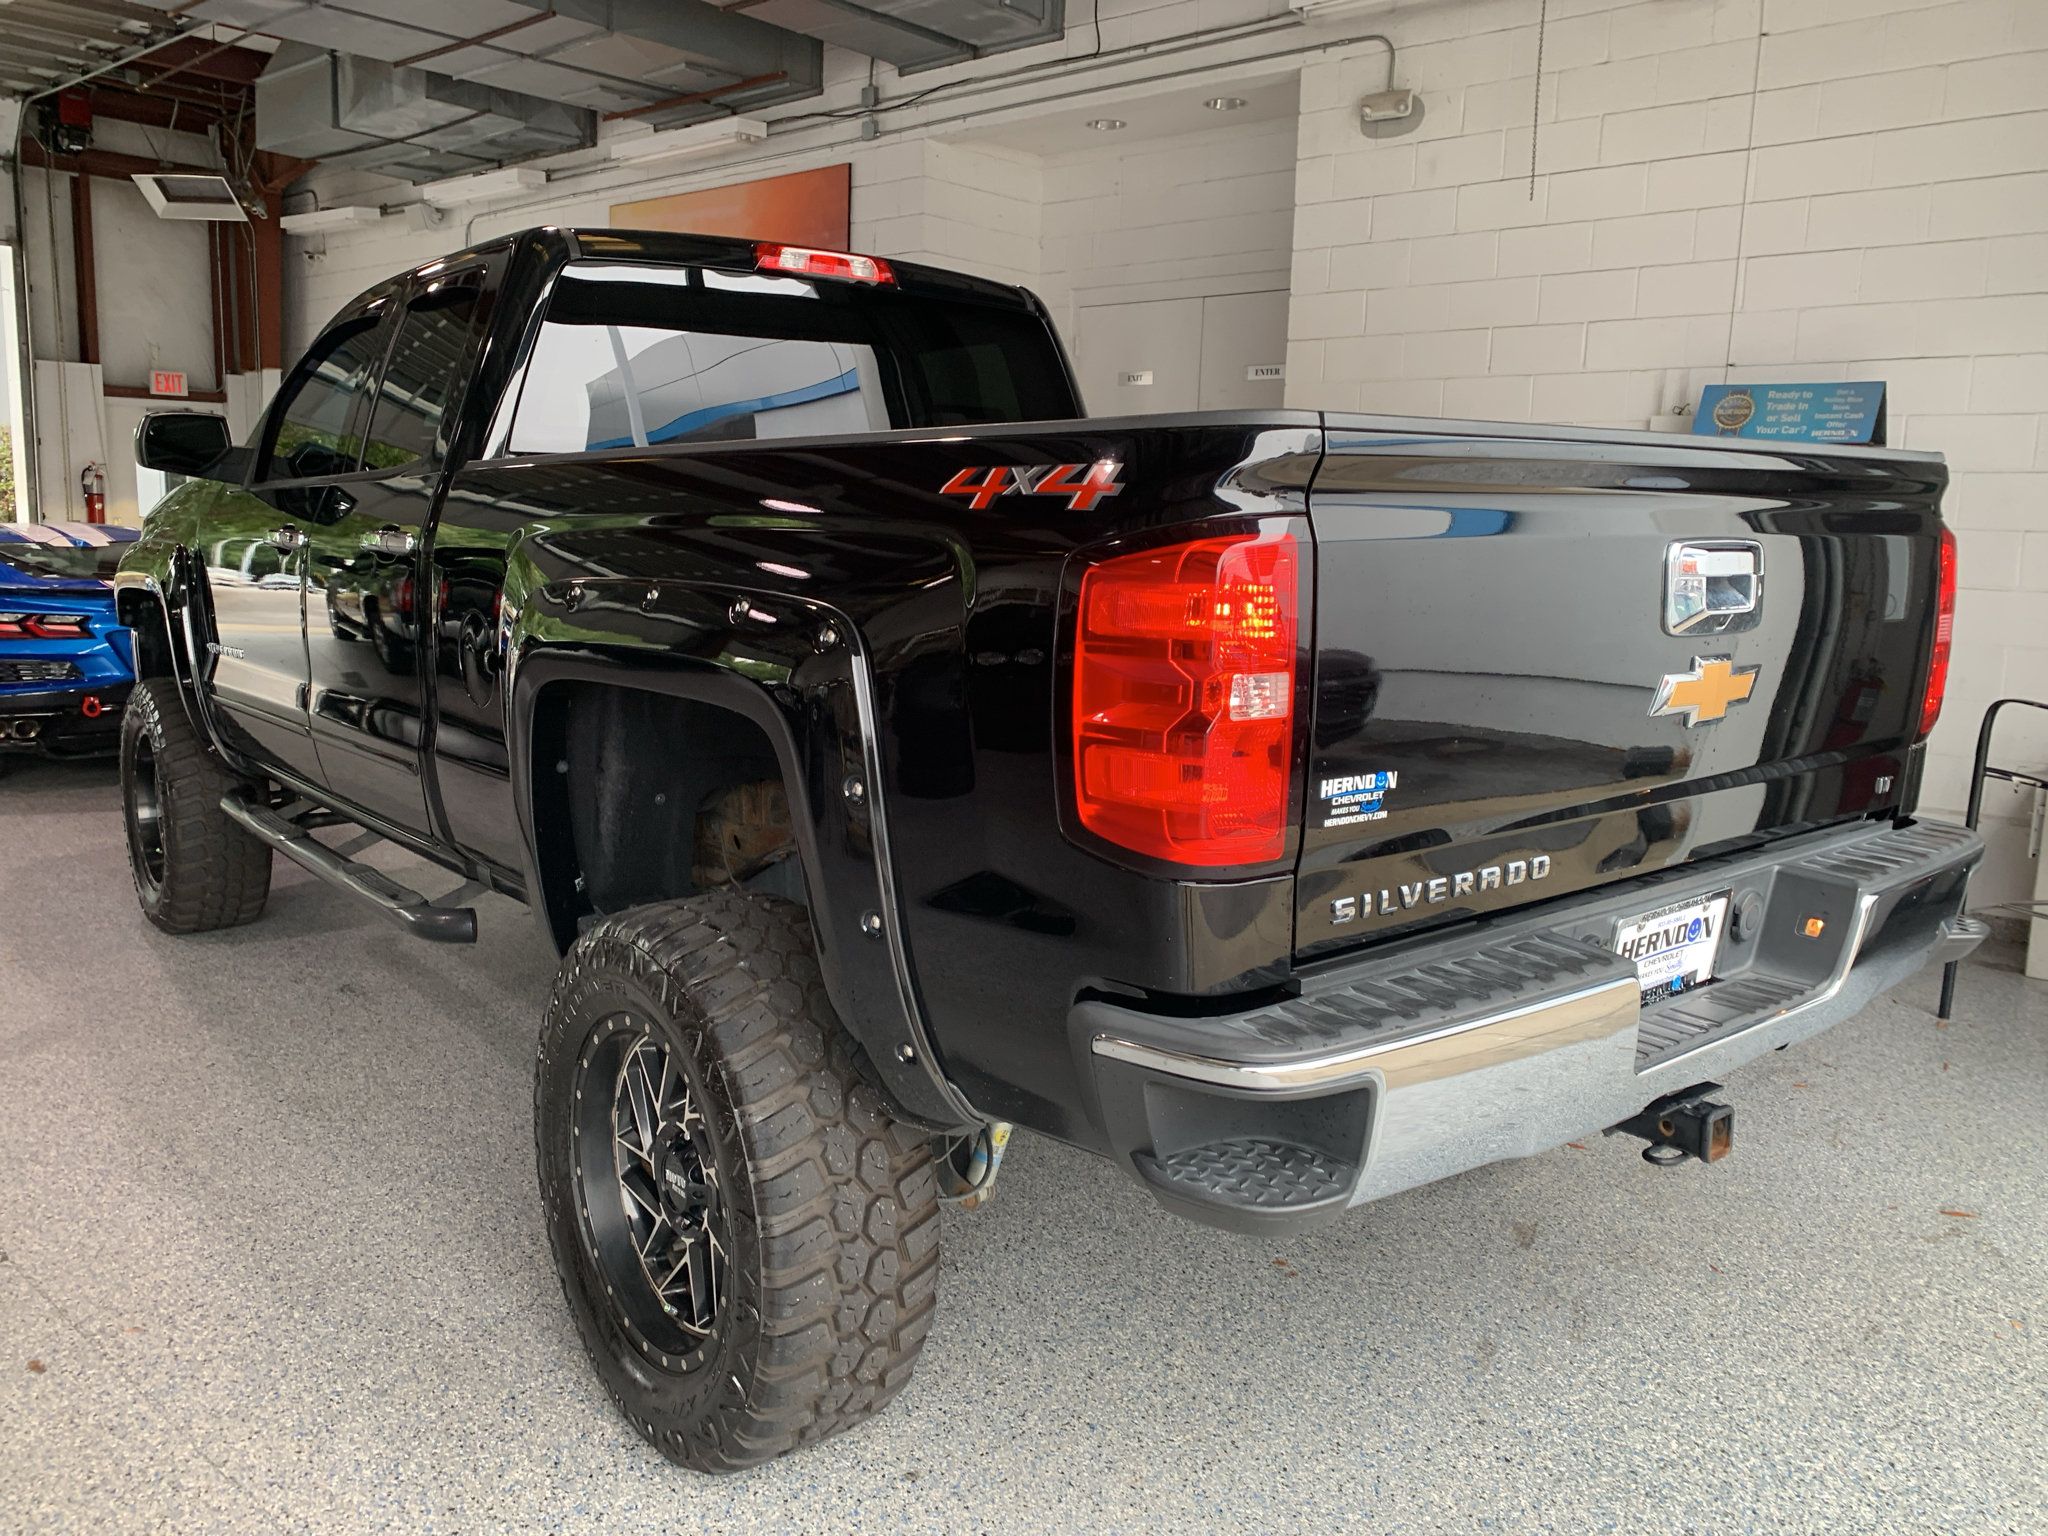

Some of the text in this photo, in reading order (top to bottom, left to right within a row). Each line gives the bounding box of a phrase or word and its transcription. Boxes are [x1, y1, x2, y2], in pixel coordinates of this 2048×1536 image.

[1127, 374, 1143, 382] EXIT
[1255, 368, 1280, 376] ENTER
[154, 372, 183, 393] EXIT
[1767, 390, 1814, 400] Ready to
[1766, 401, 1796, 410] Trade
[1766, 413, 1801, 423] or Sell
[1755, 425, 1807, 434] Your Car?
[1320, 770, 1398, 798] HERNDON
[1331, 791, 1385, 806] CHEVROLET
[1330, 806, 1349, 815] MAKES
[1349, 805, 1360, 813] YOU
[1323, 811, 1388, 828] HERNDONCHEVY.COM
[1329, 855, 1551, 925] SILVERADO
[1621, 914, 1716, 960] HERNDON
[1643, 950, 1684, 968] CHEVROLET
